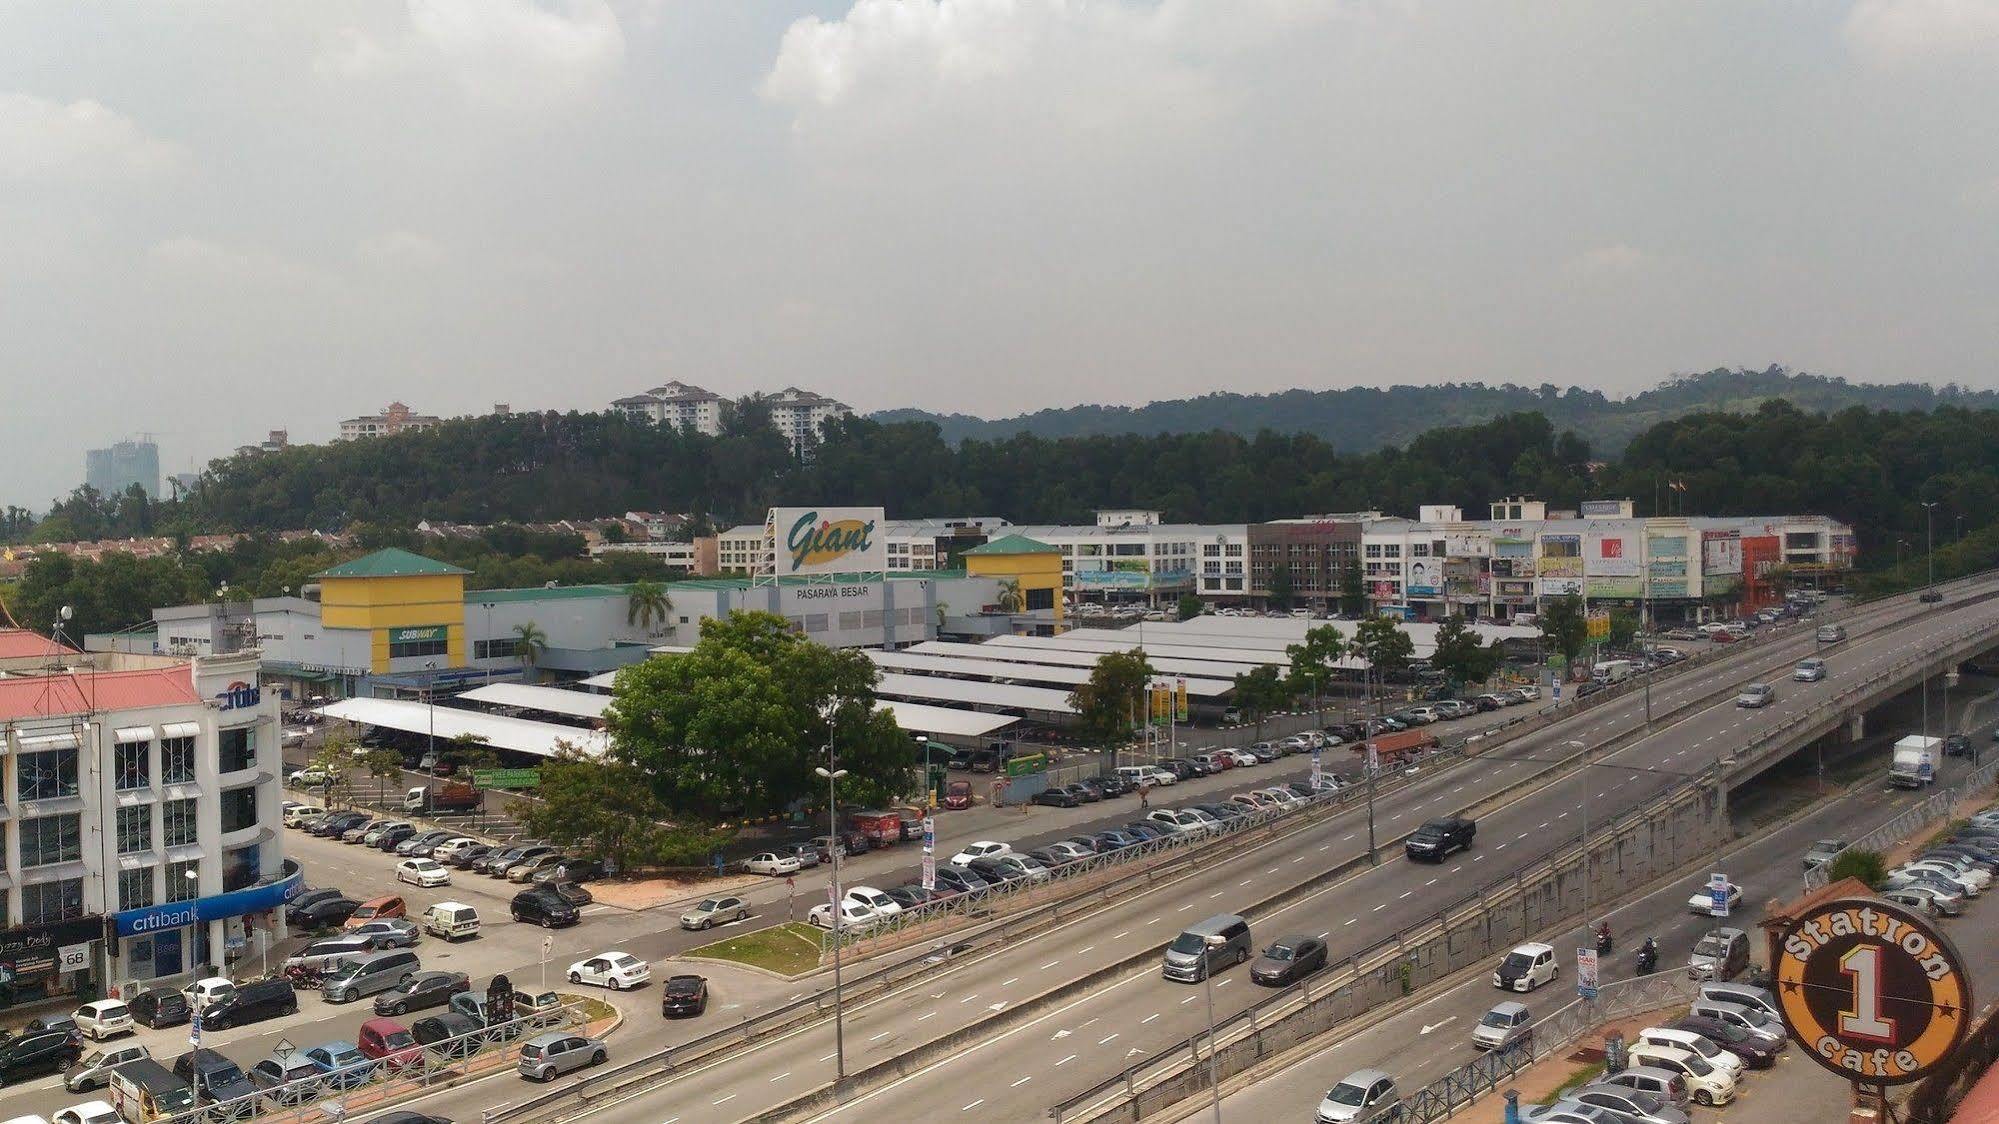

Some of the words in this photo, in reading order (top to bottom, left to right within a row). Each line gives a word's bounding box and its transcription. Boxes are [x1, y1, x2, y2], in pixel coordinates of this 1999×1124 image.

[788, 511, 875, 571] Giant
[797, 588, 838, 600] PASARAYA
[841, 586, 869, 597] BESAR
[399, 629, 437, 640] SUBWAY
[133, 906, 199, 931] citibank
[1838, 943, 1898, 1045] 1
